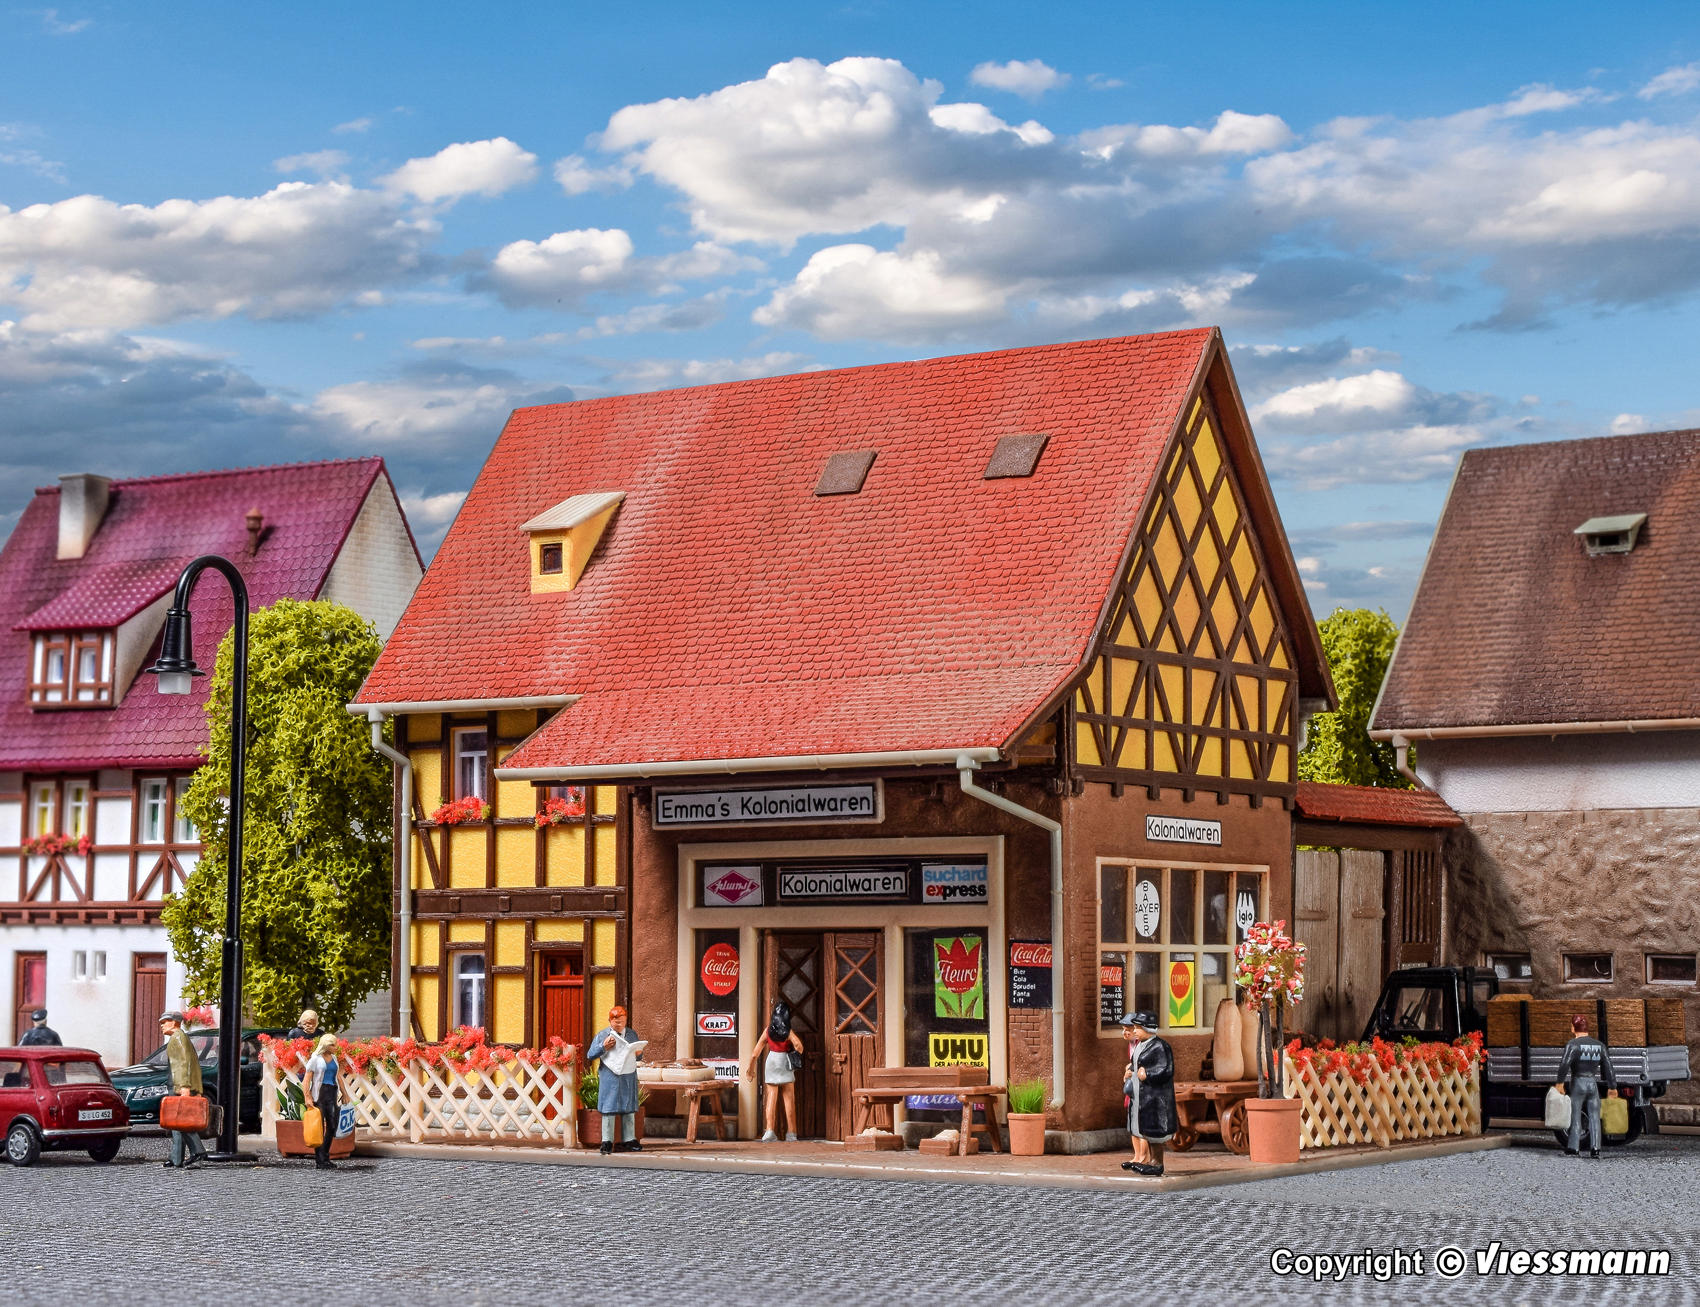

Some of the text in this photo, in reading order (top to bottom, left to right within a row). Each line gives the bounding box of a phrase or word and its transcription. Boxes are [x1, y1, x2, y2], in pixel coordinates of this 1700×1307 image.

[661, 793, 871, 820] Emma's Kolonialwaren
[1147, 818, 1220, 843] Kolonialwaren
[923, 866, 987, 883] suchard
[713, 879, 752, 897] Trumpf
[782, 873, 903, 895] Kolonialwaren
[926, 882, 987, 900] express
[1239, 910, 1252, 924] iglo
[1013, 975, 1027, 983] Cola
[1013, 982, 1036, 990] Sprudel
[1172, 974, 1189, 986] COMPO
[705, 1021, 728, 1029] KRAFT
[934, 1039, 983, 1061] UHU
